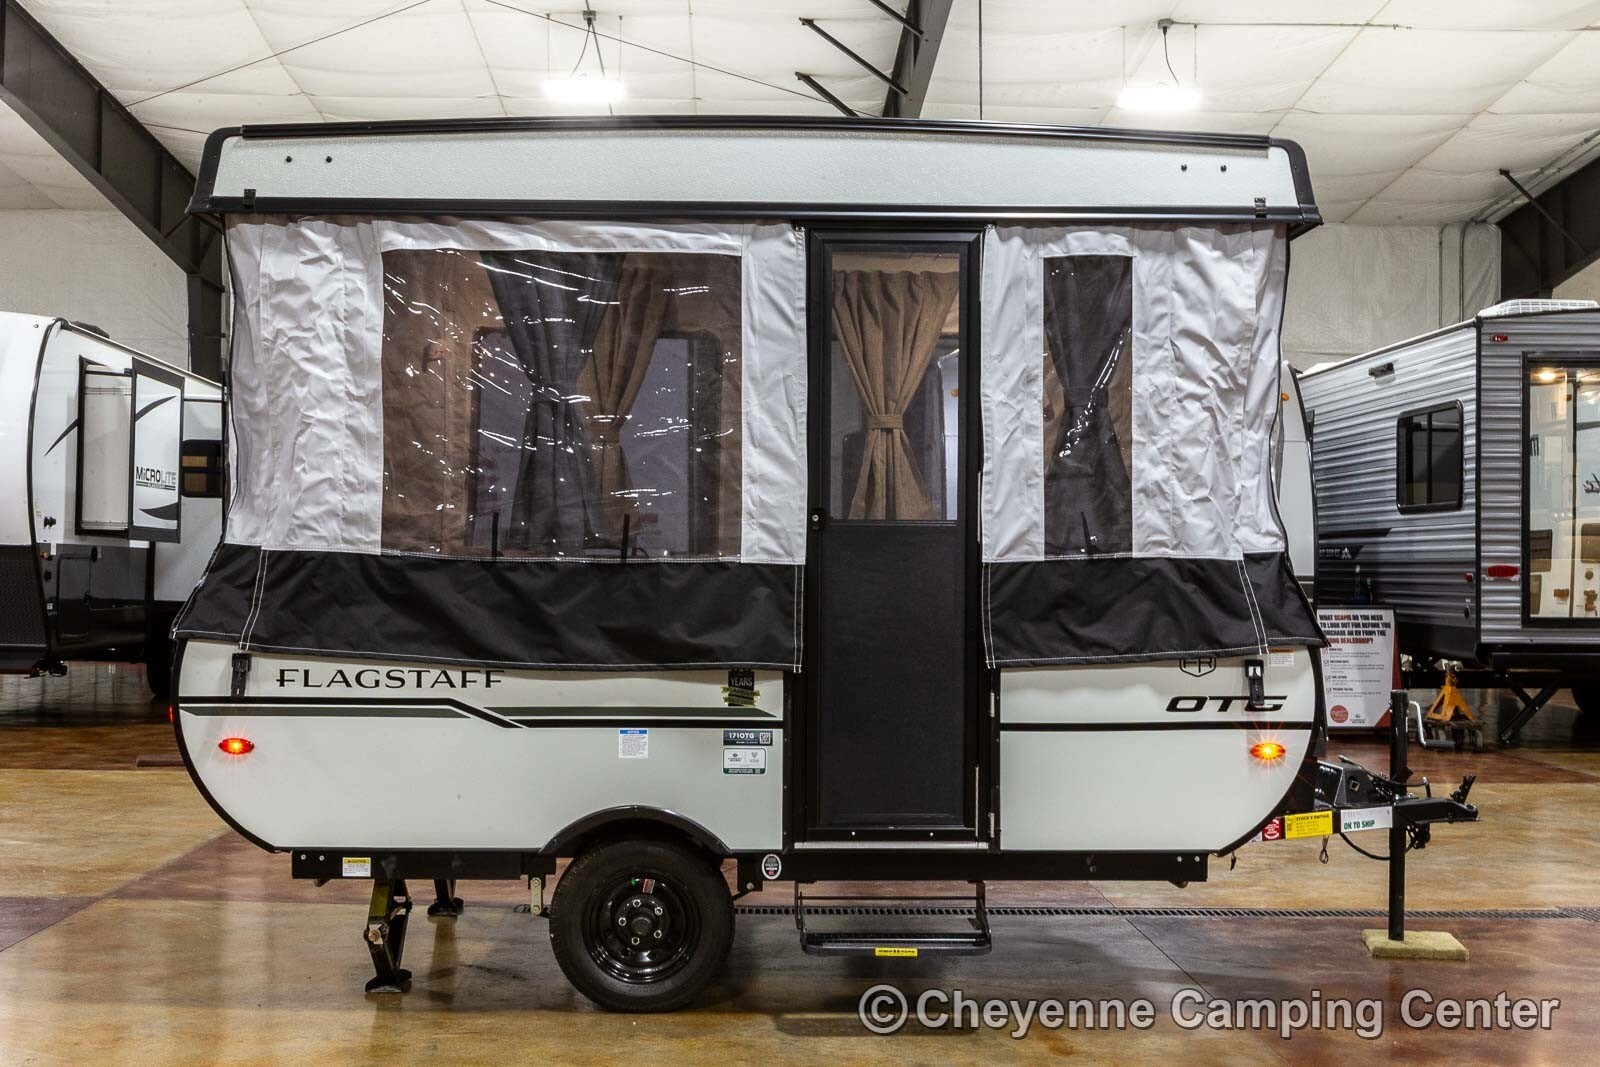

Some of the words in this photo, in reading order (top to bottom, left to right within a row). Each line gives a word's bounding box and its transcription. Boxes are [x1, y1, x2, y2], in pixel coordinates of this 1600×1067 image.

[276, 668, 505, 689] FLAGSTAFF
[730, 677, 753, 687] YEARS
[1166, 695, 1288, 713] OTG
[1343, 821, 1353, 830] OK
[1353, 821, 1361, 829] TO
[1361, 819, 1376, 828] SHIP
